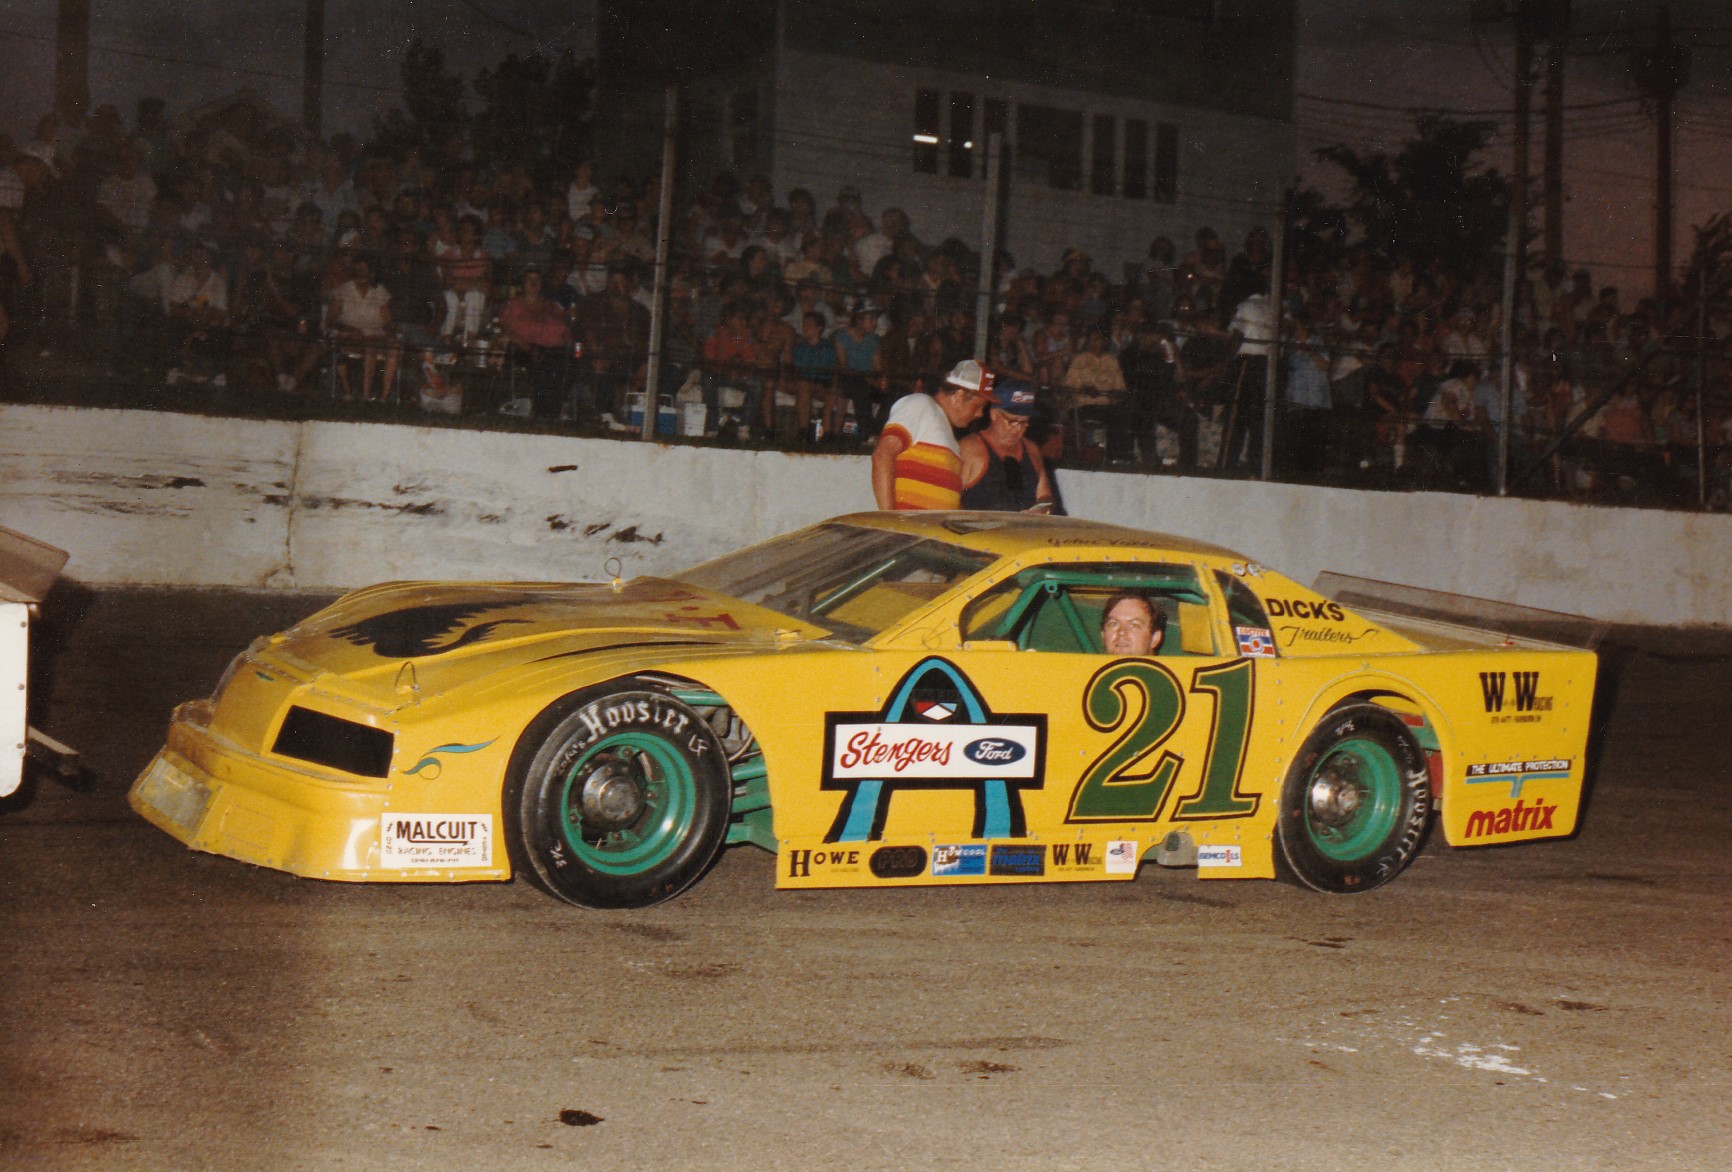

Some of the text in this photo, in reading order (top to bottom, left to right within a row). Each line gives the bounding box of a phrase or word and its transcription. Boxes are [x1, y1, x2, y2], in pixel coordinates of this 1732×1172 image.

[1265, 598, 1345, 622] DICK'S
[1280, 625, 1379, 646] Trailers
[840, 730, 953, 772] Stengers
[975, 741, 1014, 760] Ford
[1064, 657, 1262, 825] 21
[1471, 760, 1569, 775] THE ULTIMATE PROTECTION
[1464, 798, 1558, 838] matrix
[396, 820, 477, 841] MALCUIT
